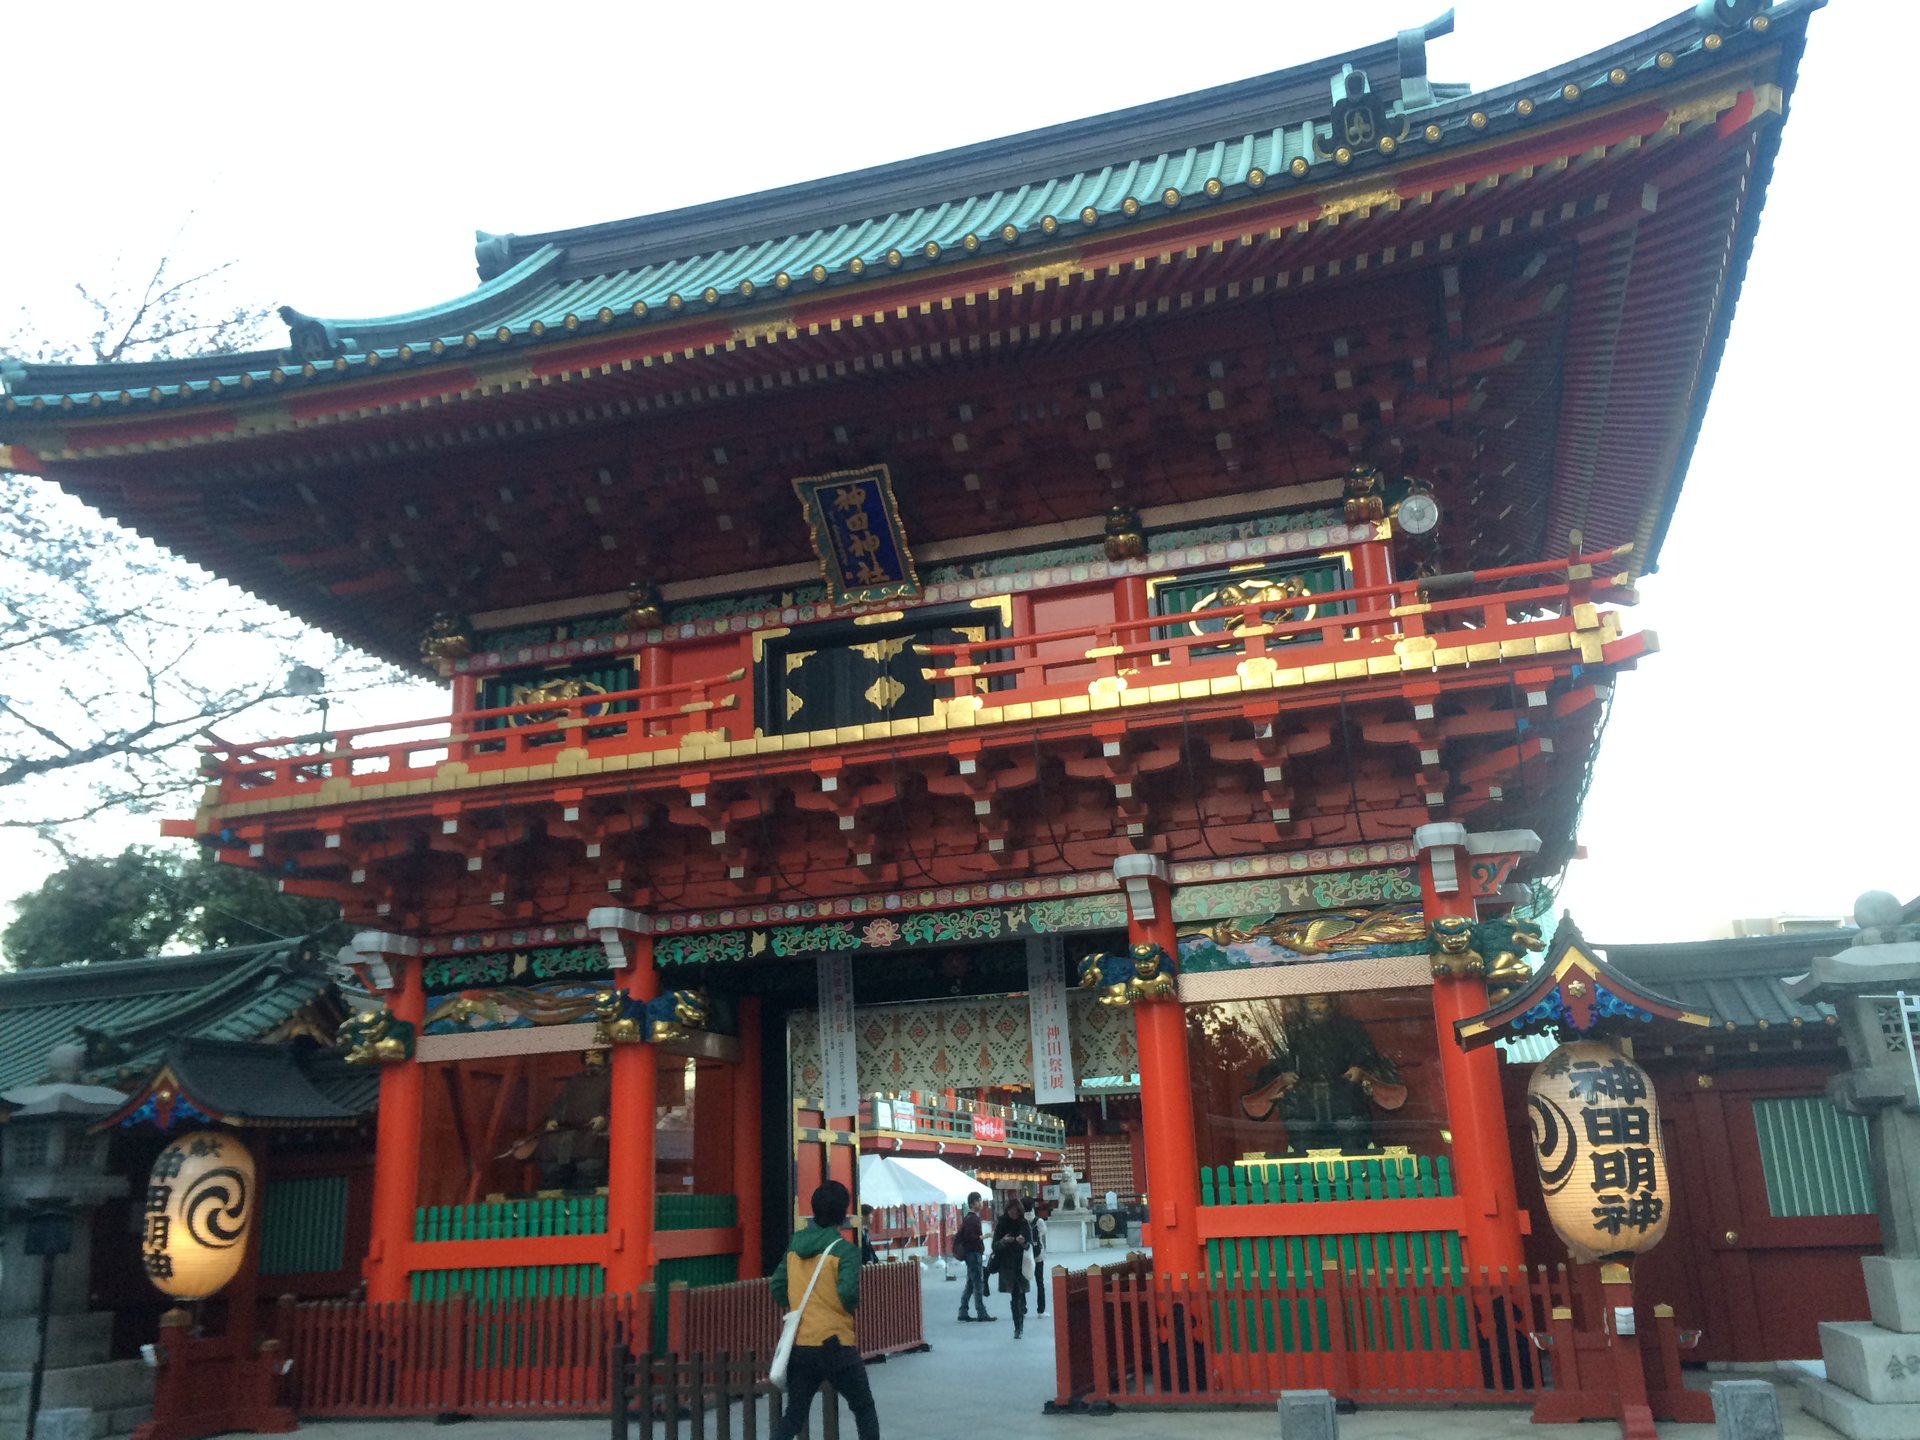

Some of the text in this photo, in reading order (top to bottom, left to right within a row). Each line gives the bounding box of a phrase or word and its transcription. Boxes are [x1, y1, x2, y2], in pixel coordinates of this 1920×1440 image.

[834, 485, 890, 585] 神田神社
[1569, 1058, 1663, 1236] 神田明神
